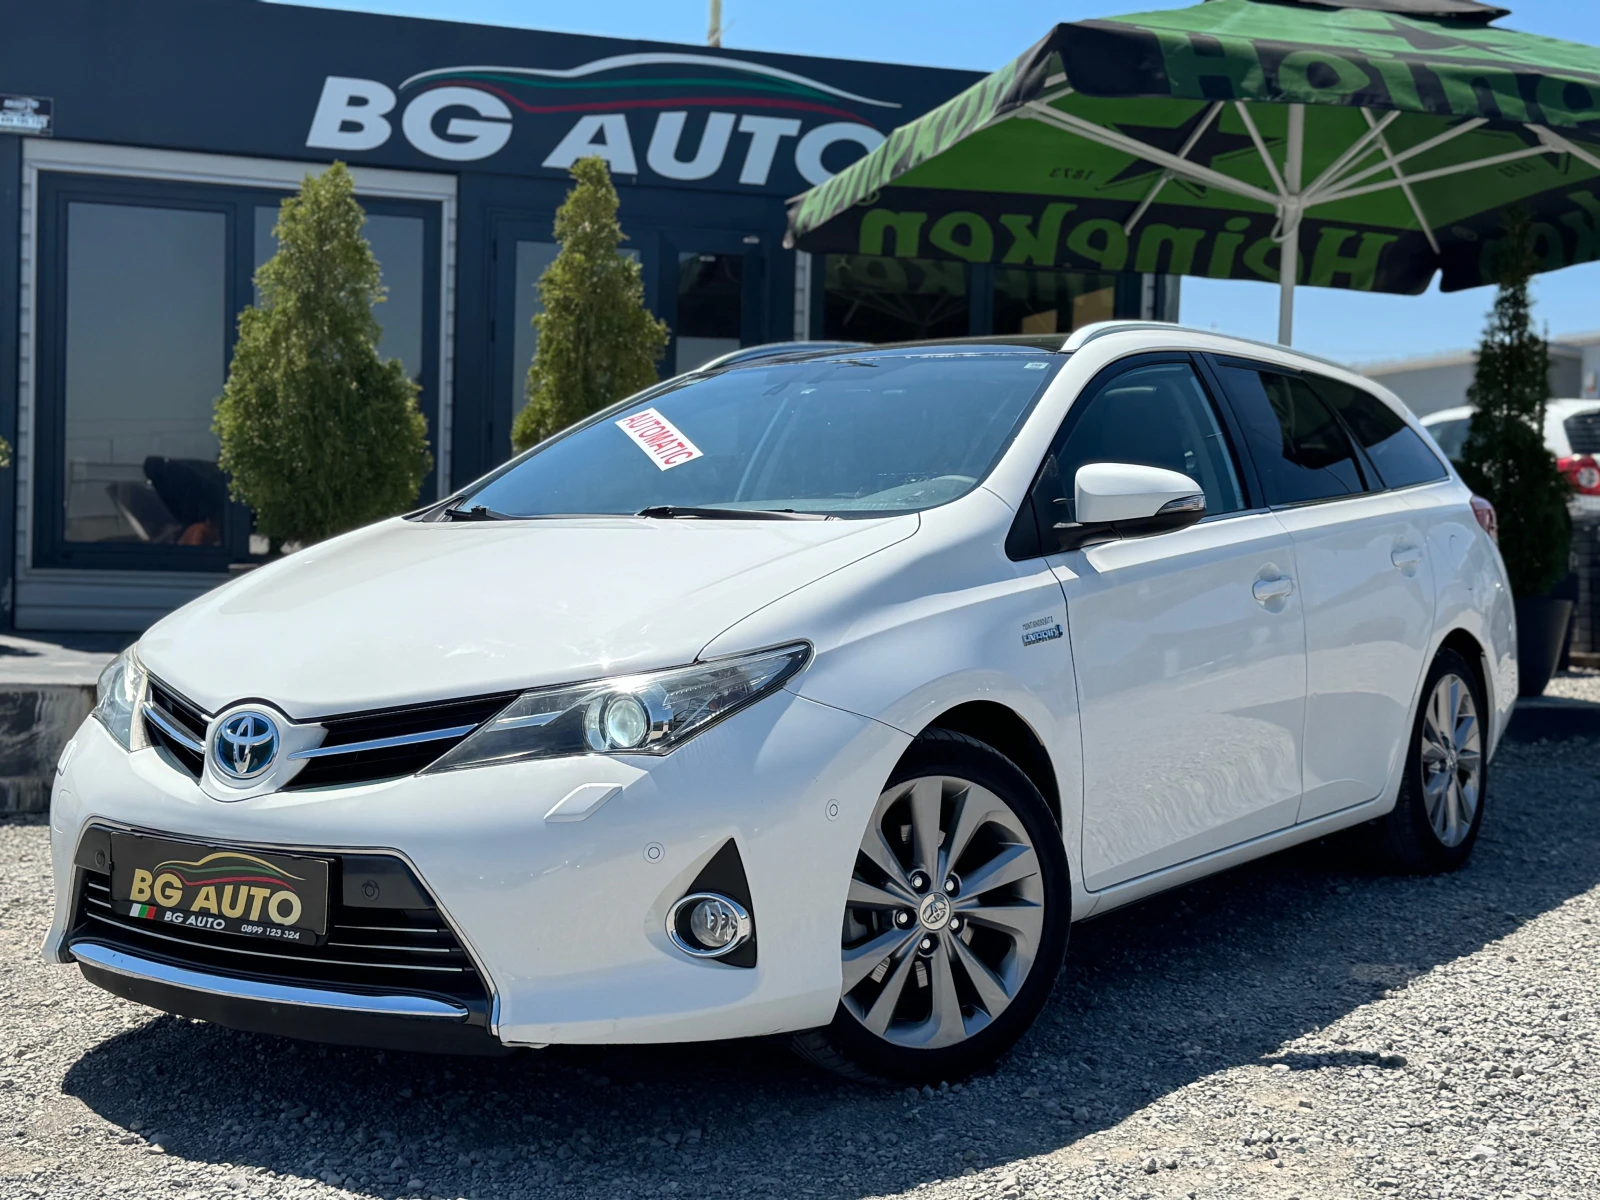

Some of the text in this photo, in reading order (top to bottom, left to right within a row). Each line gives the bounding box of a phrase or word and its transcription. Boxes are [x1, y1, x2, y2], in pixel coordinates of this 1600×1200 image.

[306, 76, 888, 186] BG AUTO
[622, 413, 693, 464] AUTOMATIC
[129, 868, 302, 926] BG AUTO
[164, 911, 226, 930] BG AUTO
[241, 924, 300, 940] 0899 123 324
